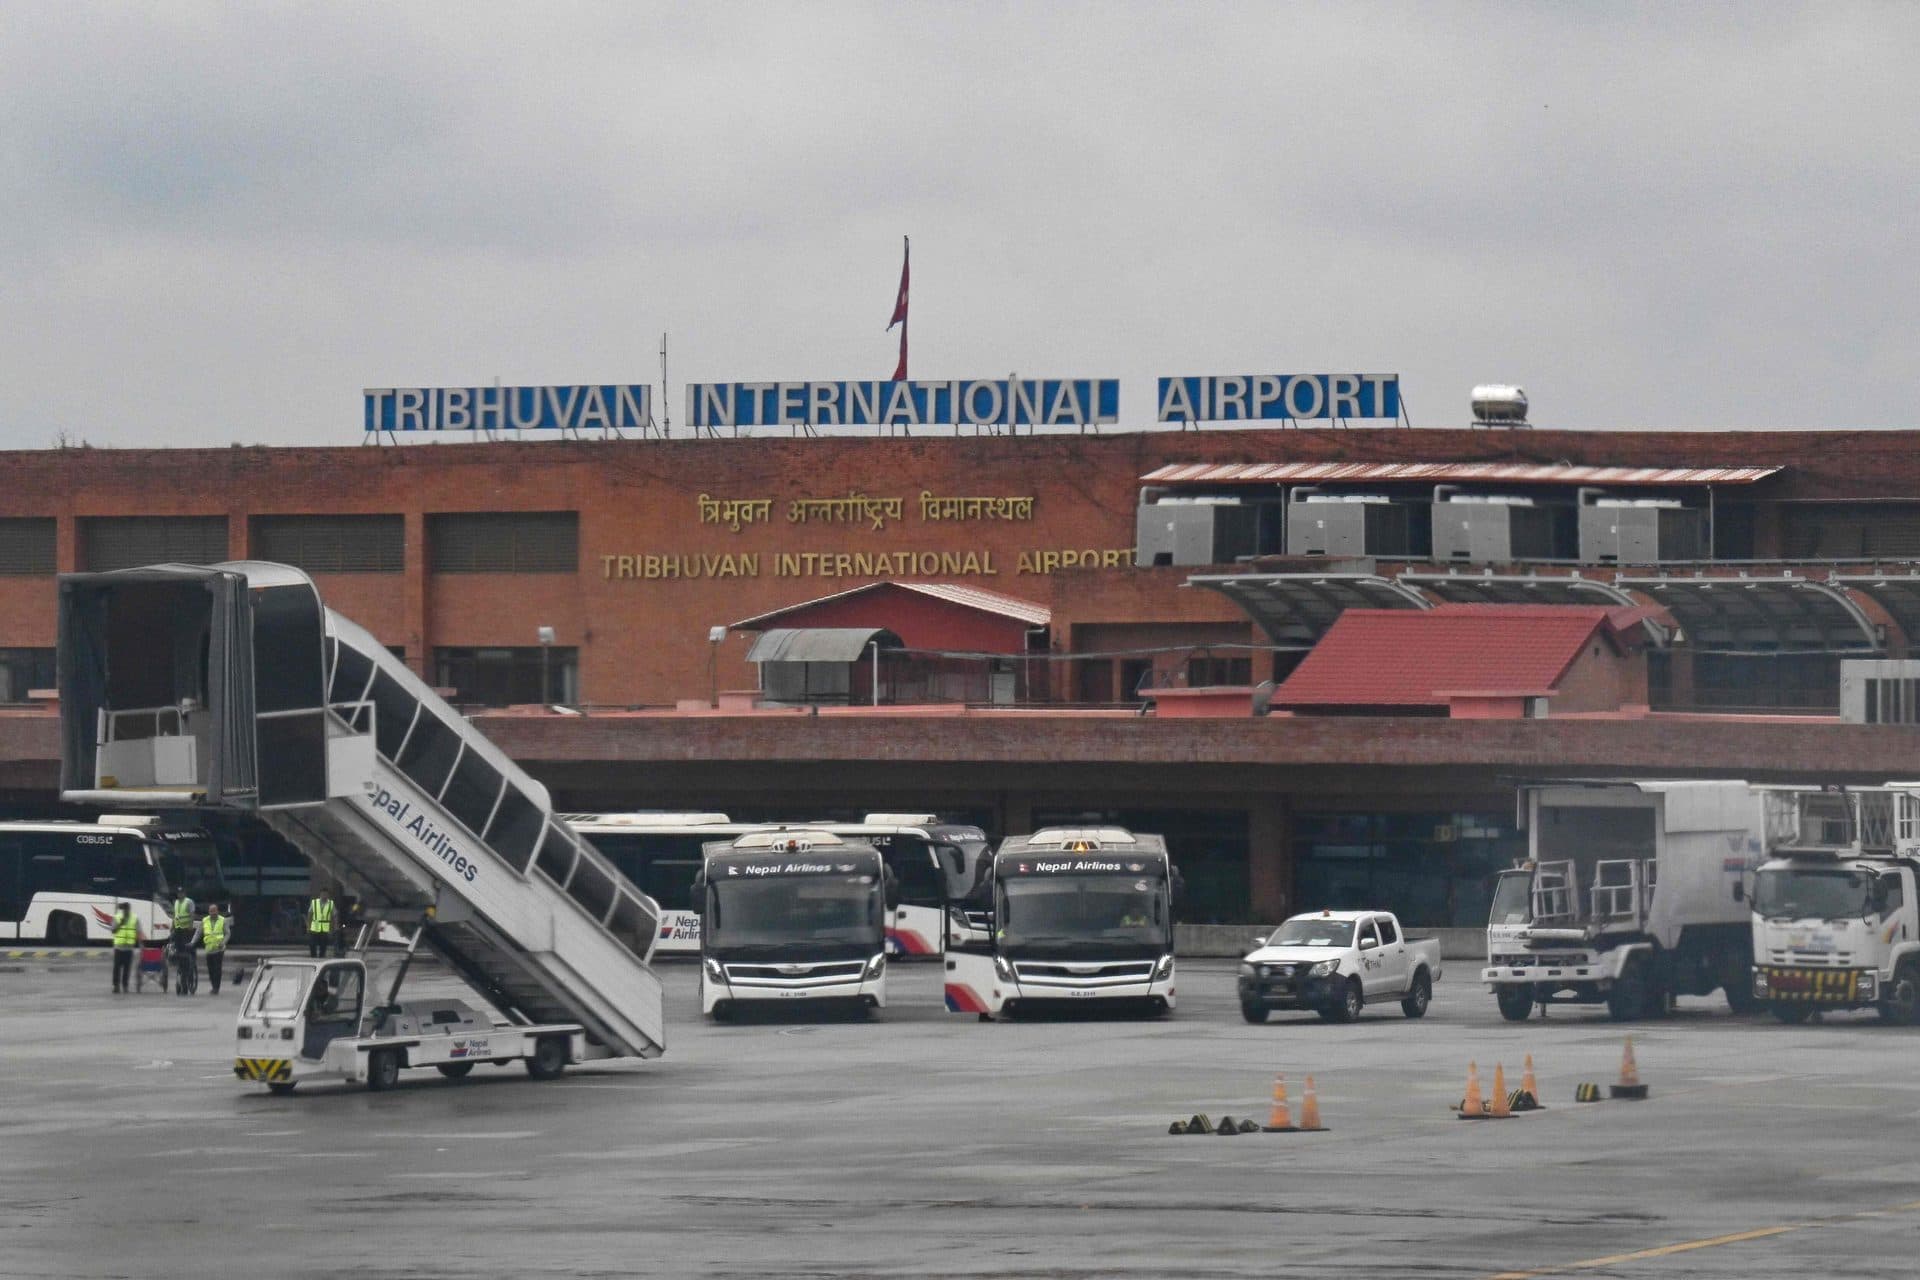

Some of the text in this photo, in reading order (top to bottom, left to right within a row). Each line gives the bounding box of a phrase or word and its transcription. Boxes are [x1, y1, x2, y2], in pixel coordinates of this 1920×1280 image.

[363, 374, 1398, 432] TRIBHUVAN INTERNATIONAL AIRPORT
[698, 493, 772, 532] त्रिभुवन
[920, 490, 1034, 521] विमानस्थल
[600, 552, 758, 579] TRIBHUVAN
[774, 551, 998, 577] INTERNATIONAL
[367, 783, 478, 882] pal Airlines
[745, 863, 832, 876] Nepal Airlines
[1036, 861, 1121, 873] Nepal Airlines
